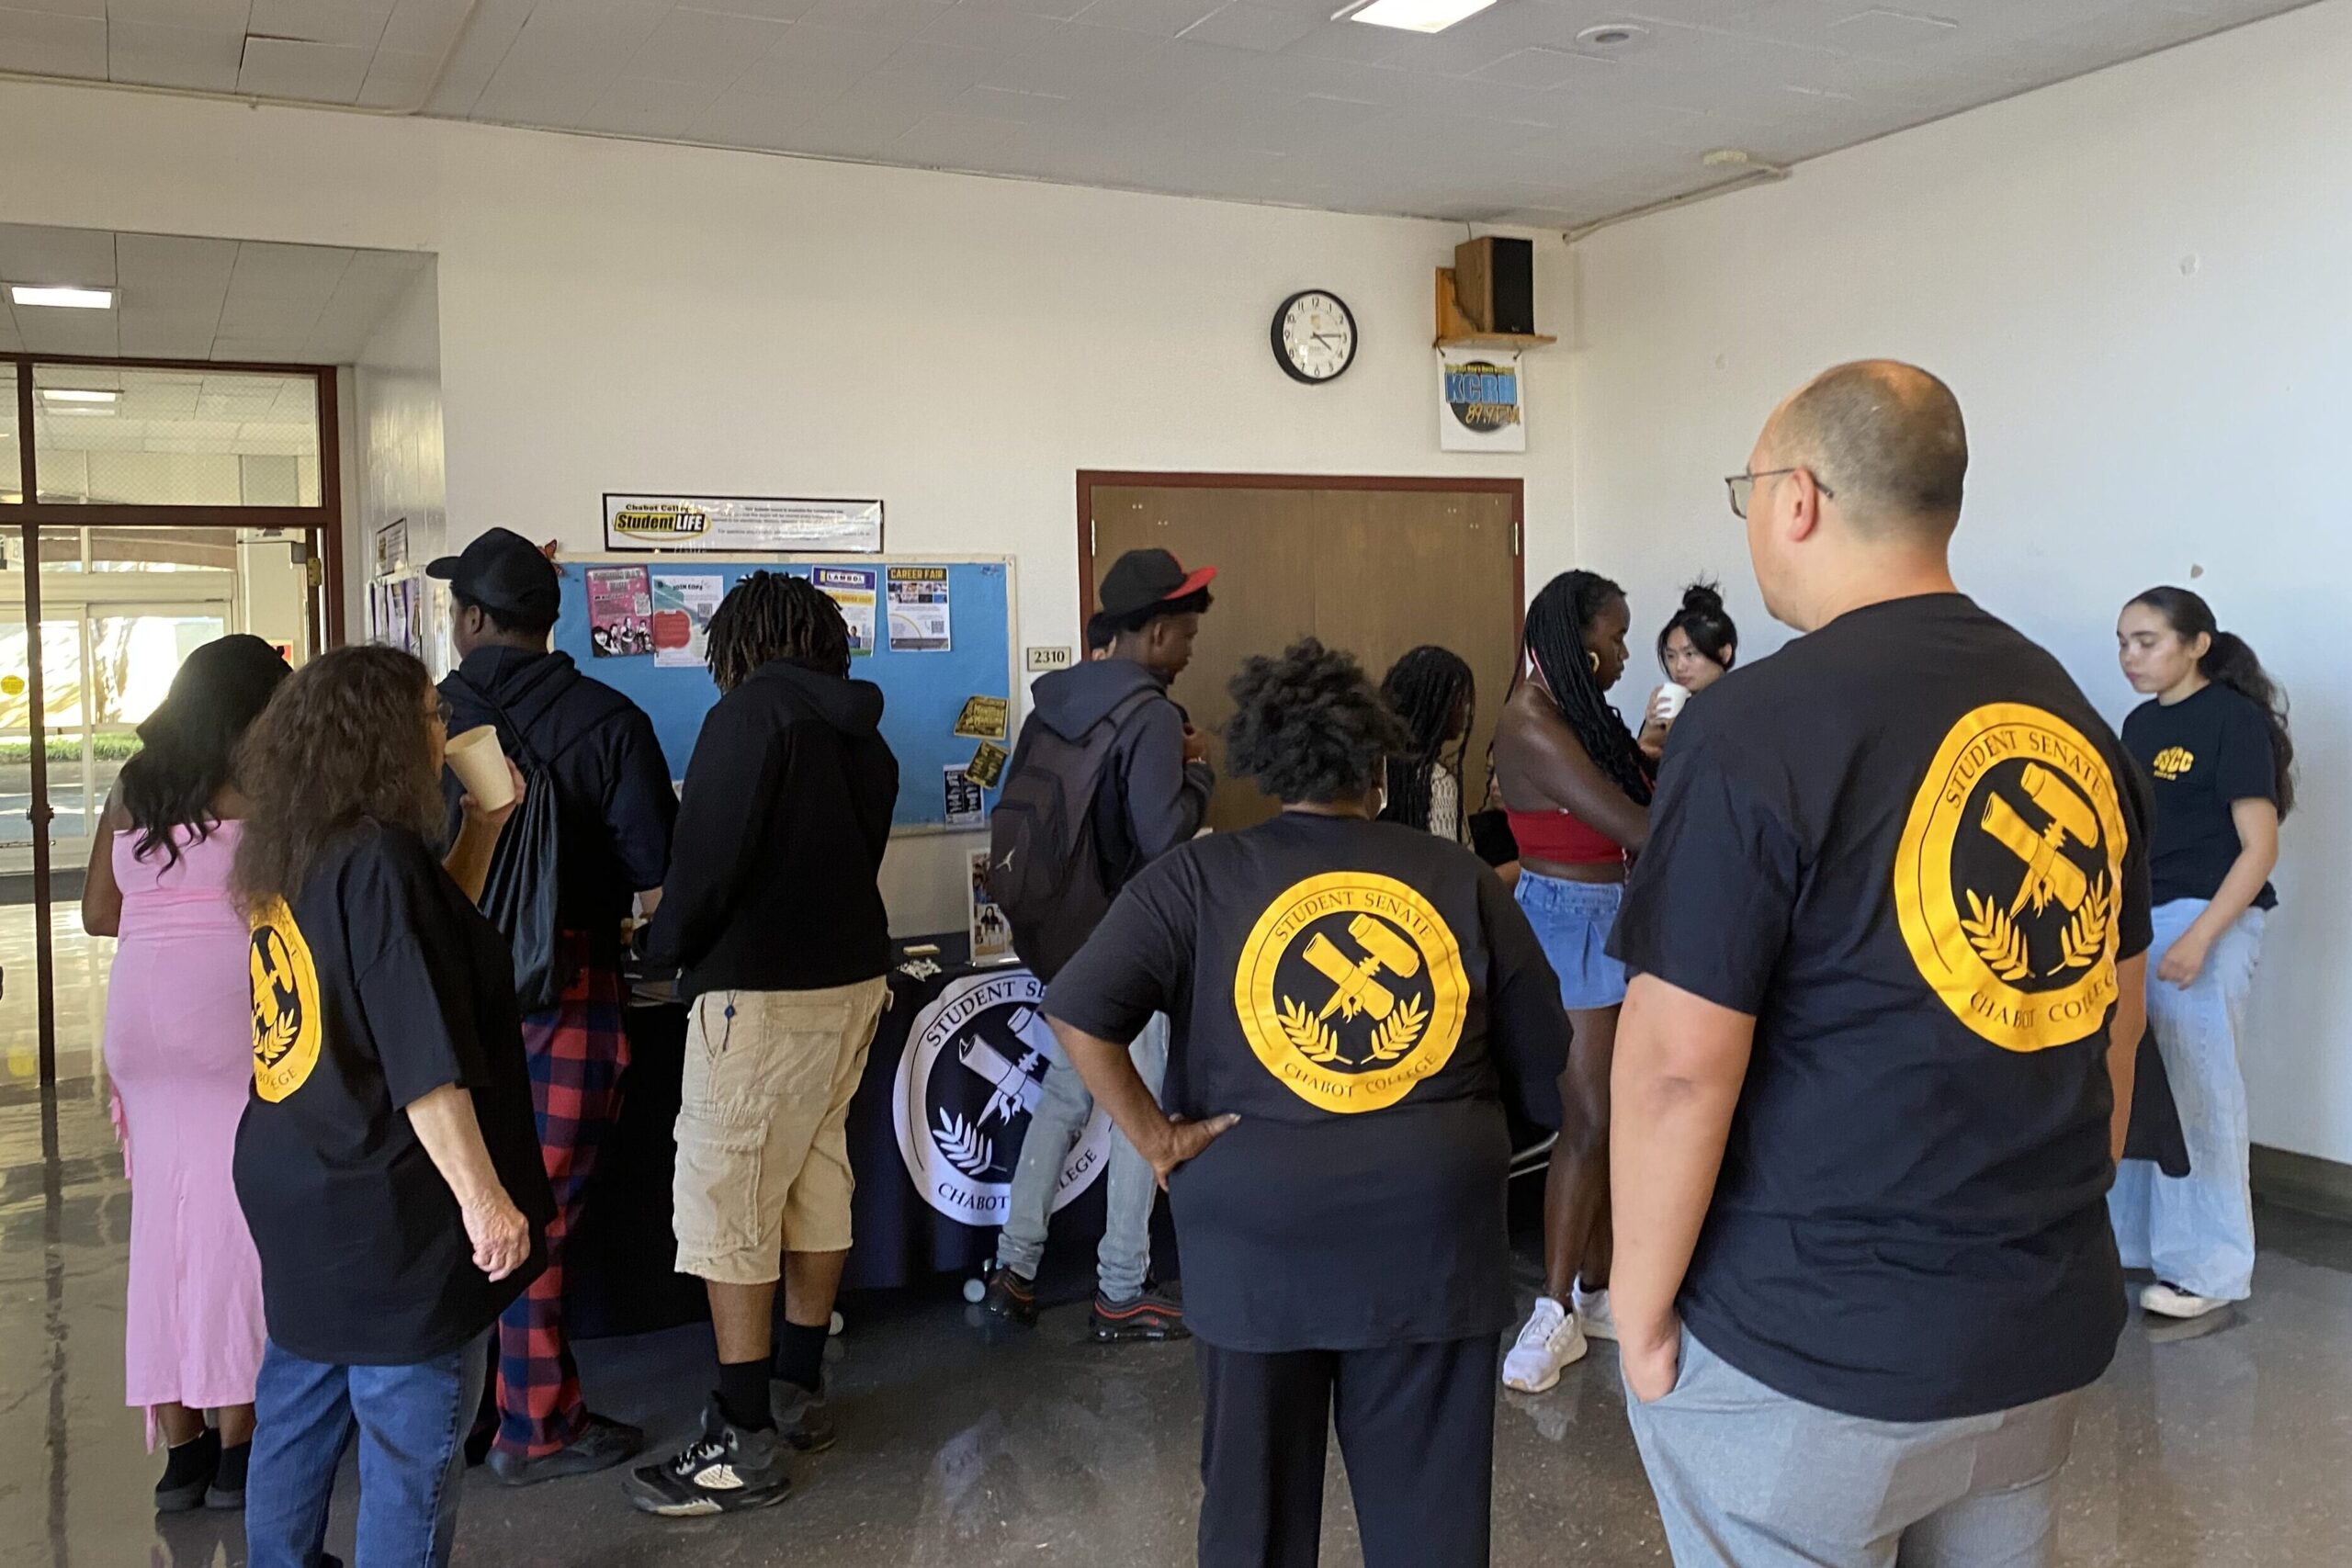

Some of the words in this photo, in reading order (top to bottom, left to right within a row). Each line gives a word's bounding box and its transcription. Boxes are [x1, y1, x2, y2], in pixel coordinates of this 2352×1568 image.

[1297, 299, 1305, 312] 11
[1311, 297, 1320, 308] 12
[1287, 313, 1295, 324] 10
[1283, 330, 1291, 341] 9
[1342, 332, 1348, 344] 3
[1288, 348, 1295, 359] 8
[1314, 364, 1320, 378] 6
[625, 502, 659, 512] Chabot
[661, 503, 693, 513] Colleg
[890, 569, 922, 580] CAREER
[924, 570, 944, 580] FAIR
[1035, 651, 1065, 663] 2310
[1946, 729, 2018, 810] STUDENT
[2029, 730, 2103, 797] SENATE
[1275, 891, 1354, 942] STUDENT
[1364, 892, 1433, 940] SENATE
[1970, 990, 2036, 1030] CHABOT
[2048, 969, 2114, 1022] COLLEG
[926, 980, 1016, 1047] STUDENT
[1283, 1062, 1353, 1098] CHABOT
[1365, 1053, 1437, 1094] COLLEGE
[937, 1182, 1009, 1210] CHABOT
[1057, 1147, 1097, 1190] LEGE
